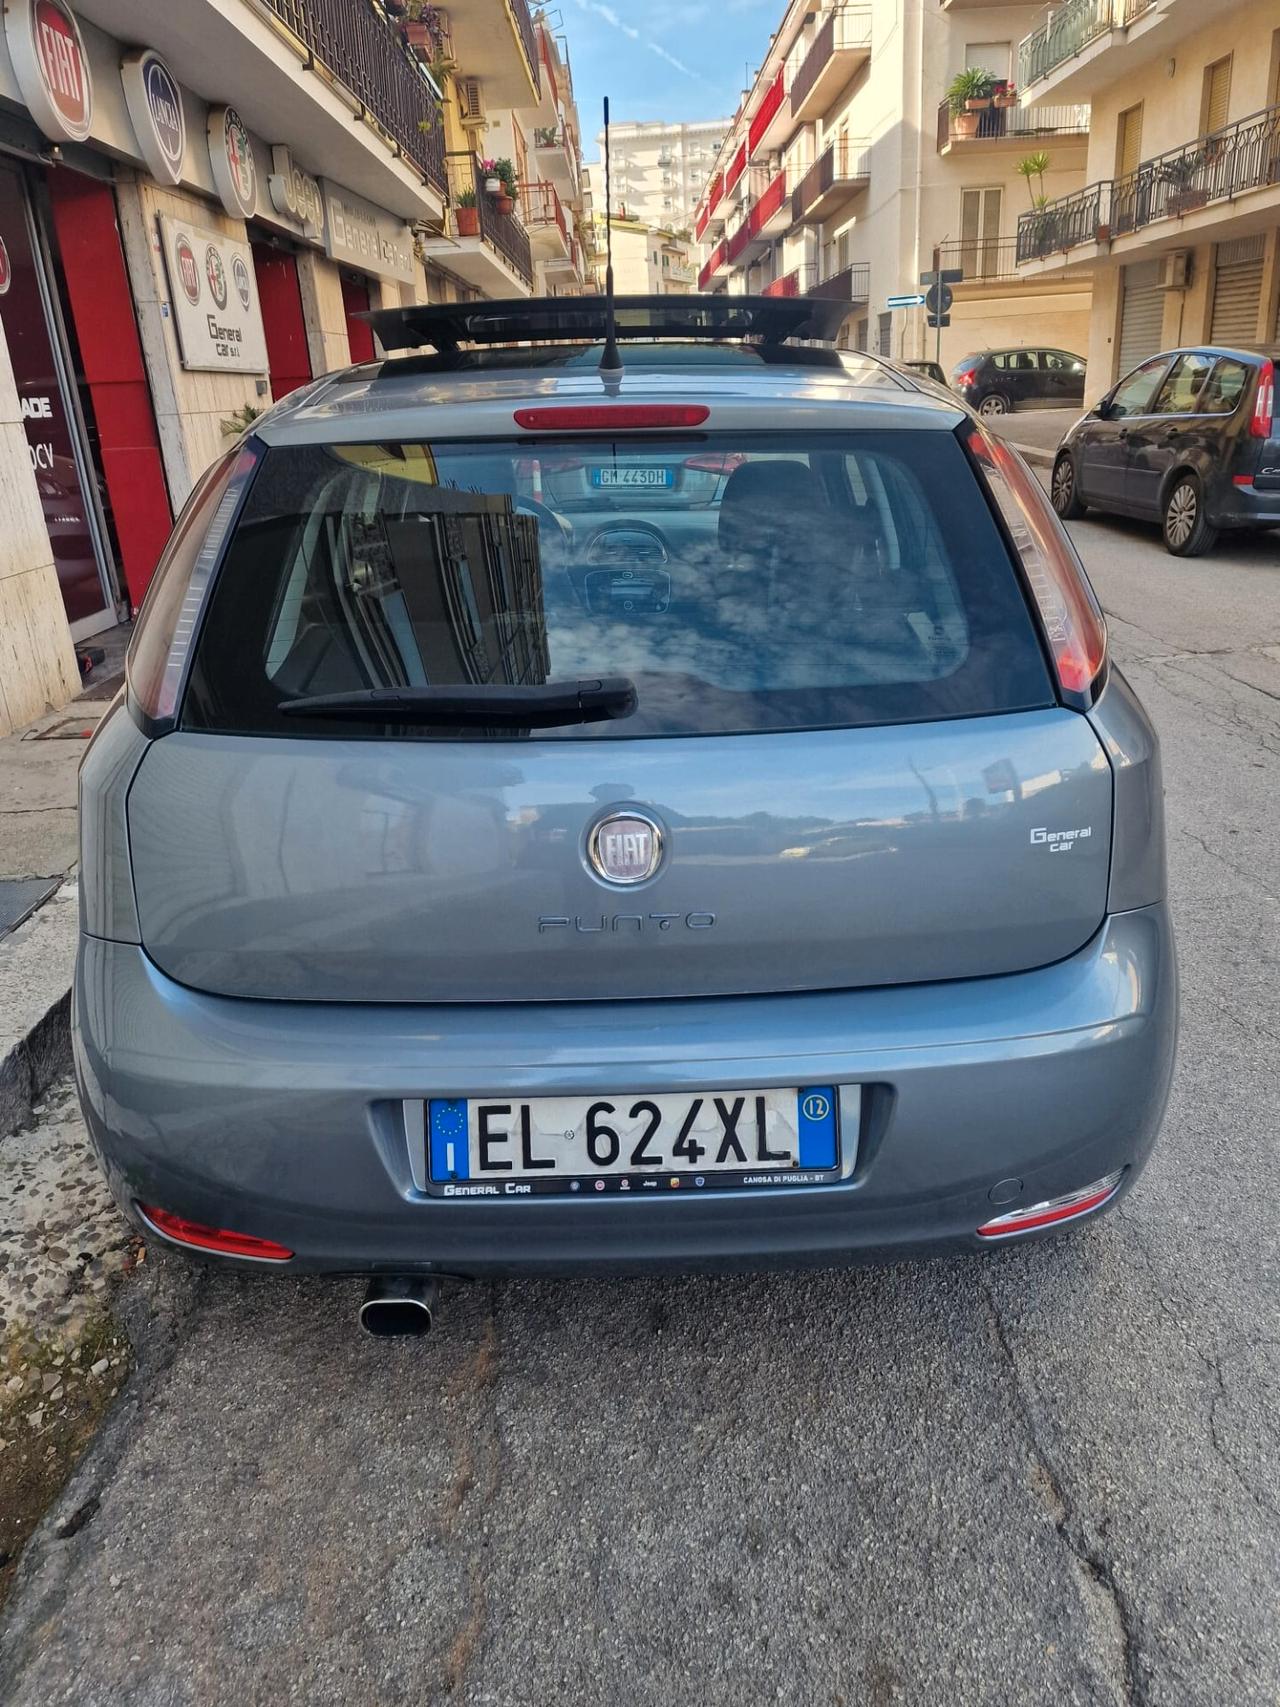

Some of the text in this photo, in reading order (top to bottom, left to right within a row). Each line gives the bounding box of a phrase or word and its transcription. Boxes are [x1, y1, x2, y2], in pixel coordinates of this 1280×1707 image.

[41, 21, 81, 102] FIAT
[282, 160, 324, 239] Jeep
[329, 197, 381, 261] General
[207, 313, 242, 342] General
[216, 343, 228, 356] car
[623, 470, 664, 483] 443DH
[1030, 826, 1091, 843] General
[1050, 841, 1073, 852] car
[606, 833, 648, 866] FIAT
[539, 912, 716, 932] PUNTO
[808, 1099, 825, 1116] 12
[478, 1096, 791, 1170] EL 624XL
[446, 1142, 455, 1171] I
[743, 1175, 772, 1183] CANOSA
[773, 1175, 781, 1183] DI
